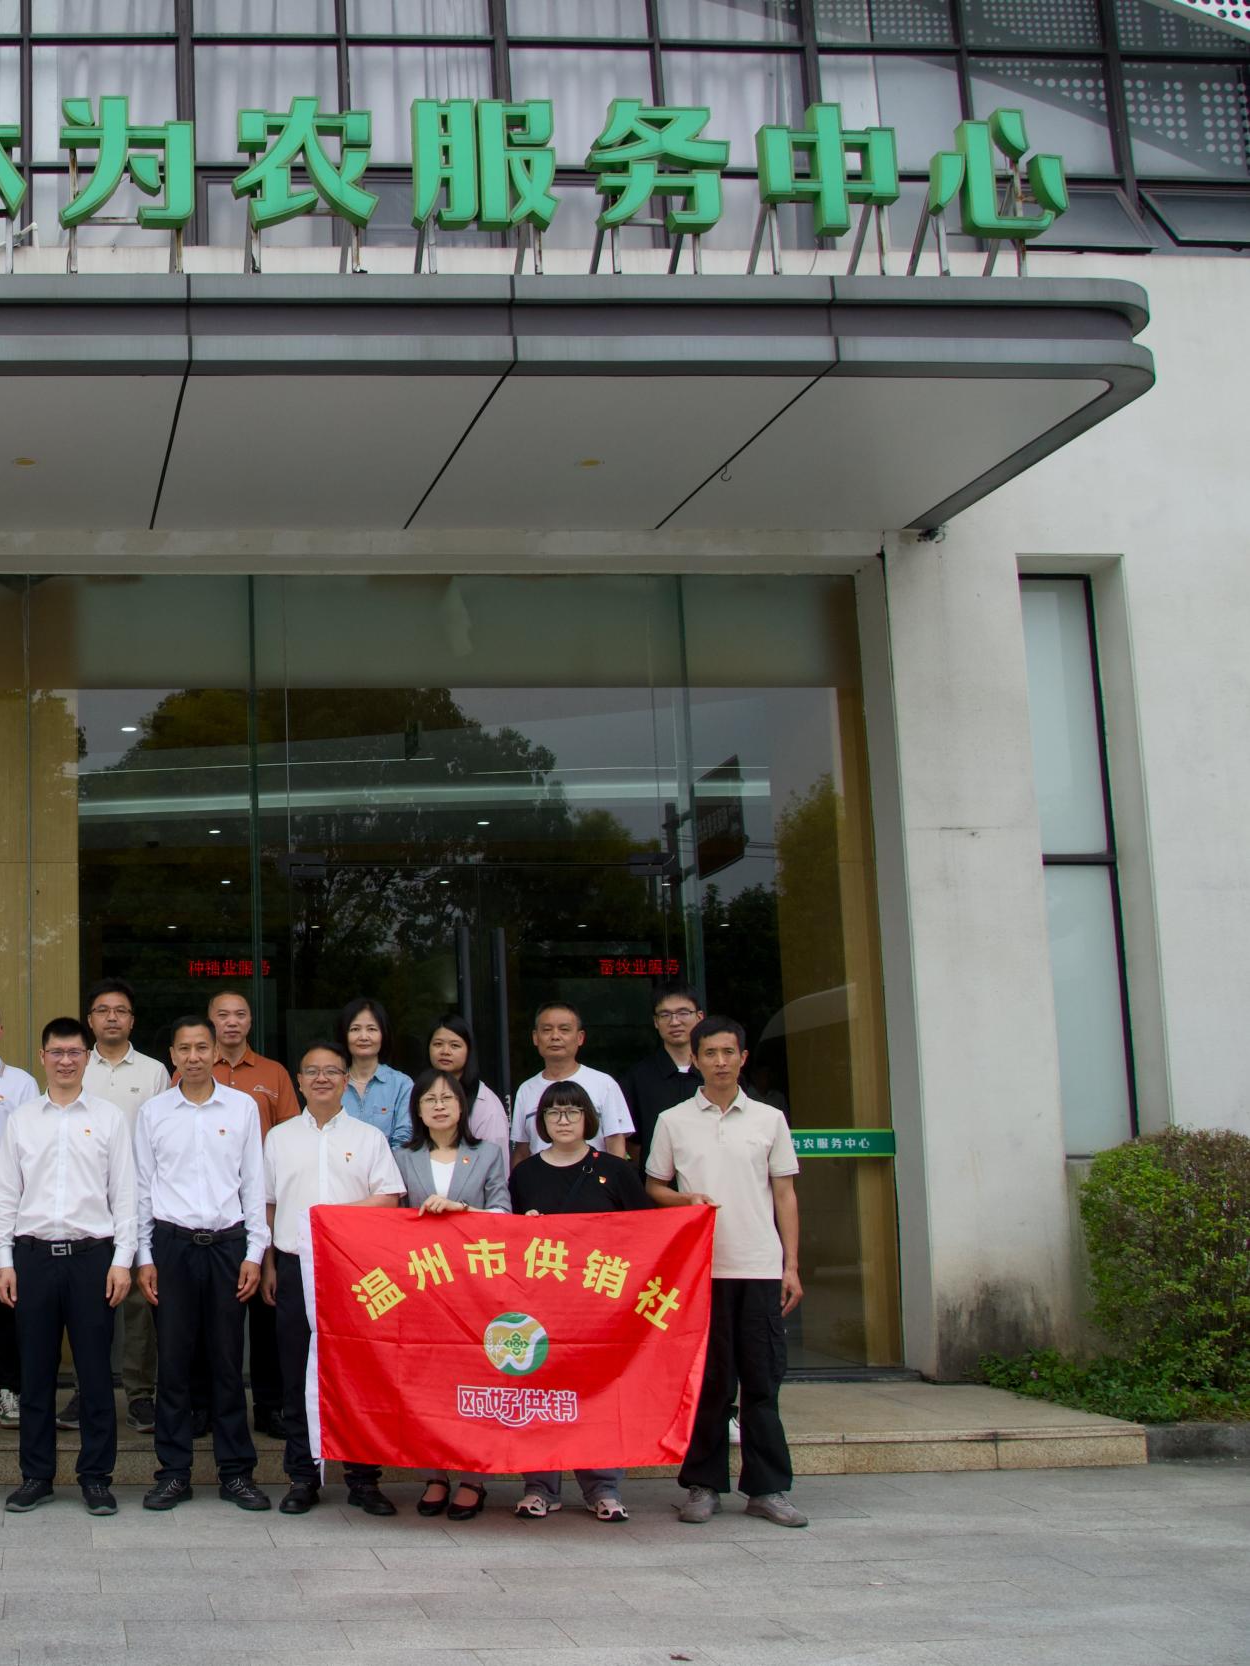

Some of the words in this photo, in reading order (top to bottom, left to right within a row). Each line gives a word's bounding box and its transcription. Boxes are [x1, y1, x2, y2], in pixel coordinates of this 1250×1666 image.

[351, 1236, 681, 1331] 温州市供销社
